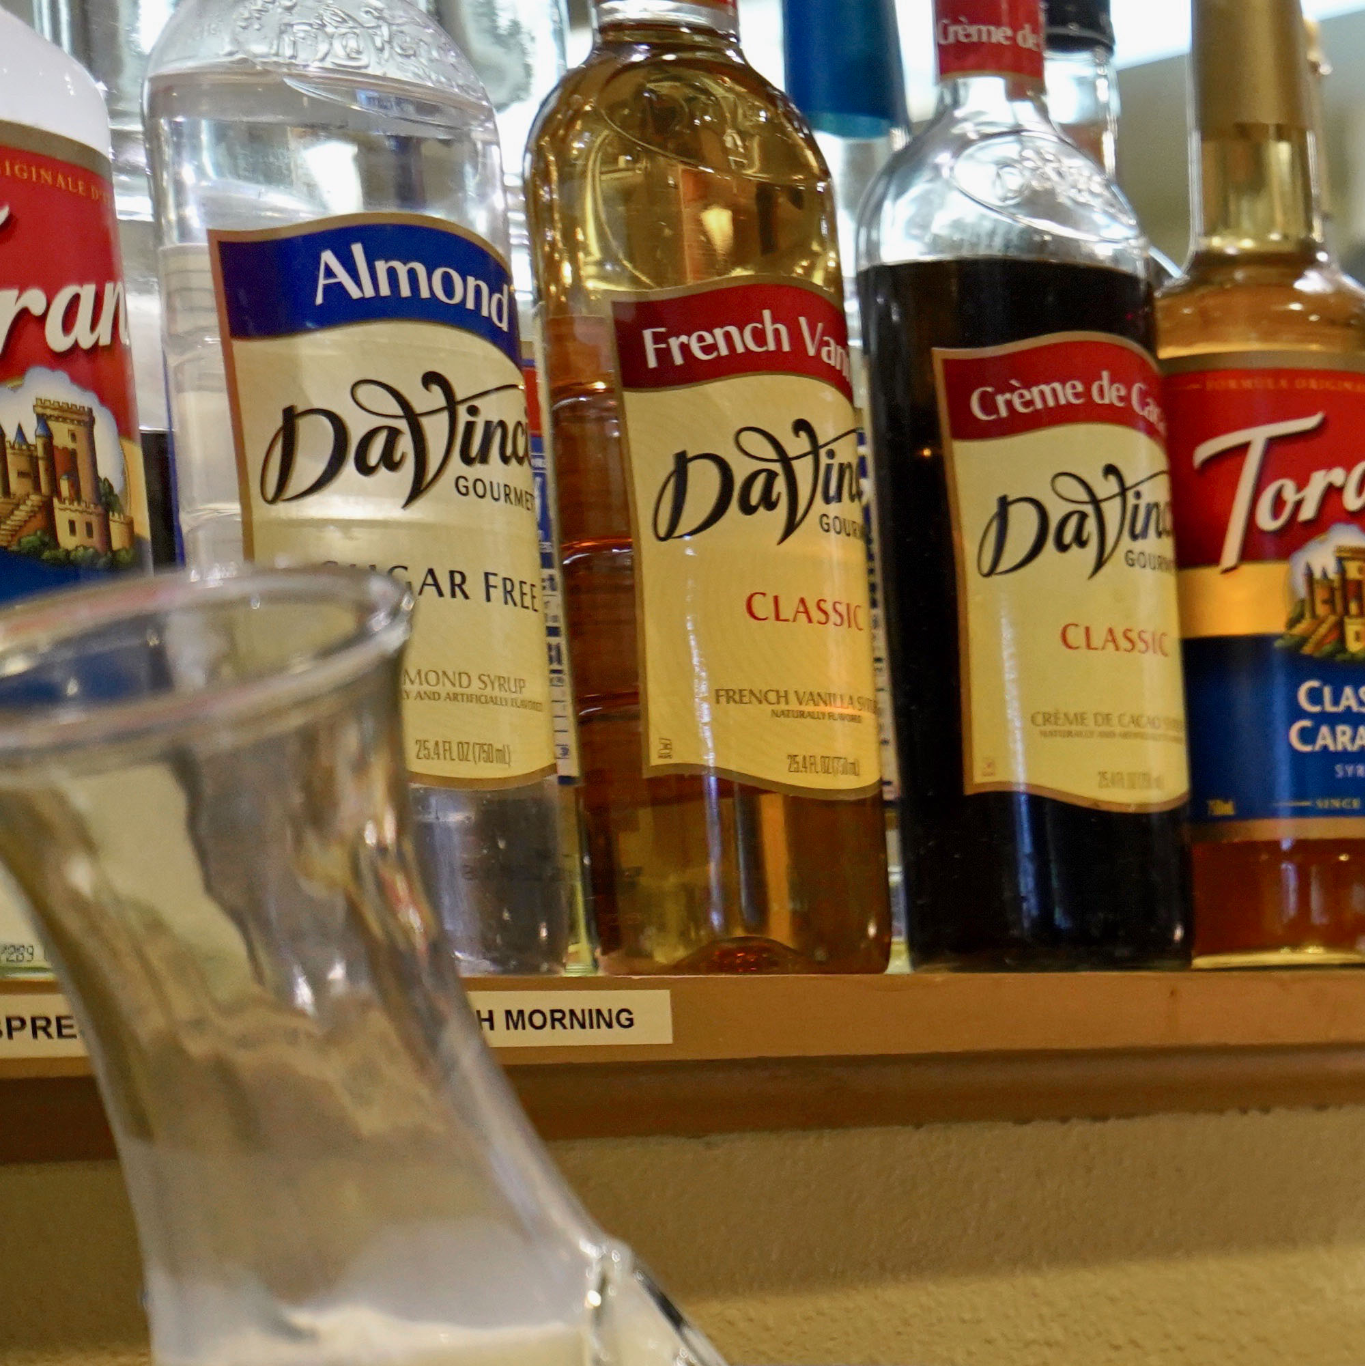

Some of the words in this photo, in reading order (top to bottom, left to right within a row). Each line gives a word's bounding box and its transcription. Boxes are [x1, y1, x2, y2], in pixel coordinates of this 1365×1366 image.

[937, 17, 1012, 45] Crème
[315, 241, 509, 333] Almond
[642, 309, 791, 369] French
[969, 378, 1085, 421] Crème
[1091, 369, 1126, 407] de
[455, 475, 536, 512] GOURME
[976, 463, 1174, 581] DaVin
[483, 570, 540, 613] FREE
[744, 591, 865, 632] CLASSIC
[1060, 622, 1170, 658] CLASSIC
[402, 668, 471, 690] MOND
[478, 672, 526, 695] SYRUP
[414, 690, 441, 703] AND
[714, 687, 790, 706] FRENCH
[793, 690, 857, 708] VANILLA
[415, 738, 439, 761] 25.4
[442, 740, 455, 762] FL
[457, 740, 471, 763] OZ
[0, 1014, 78, 1040] PRE
[504, 1007, 635, 1031] MORNING
